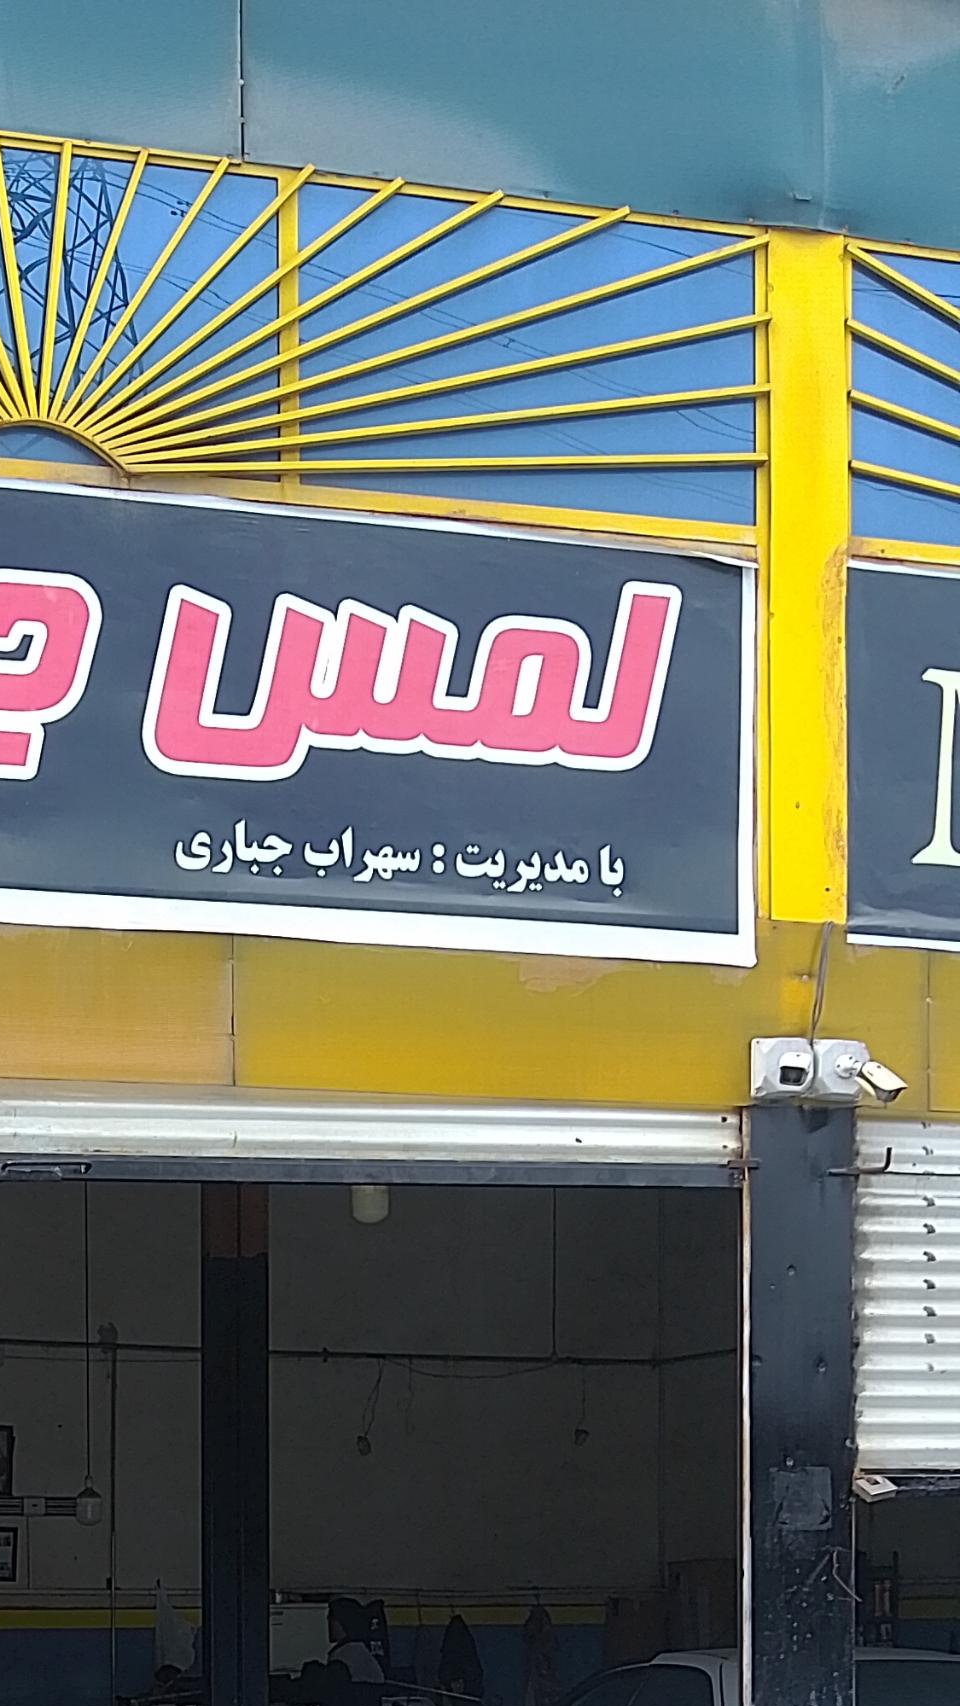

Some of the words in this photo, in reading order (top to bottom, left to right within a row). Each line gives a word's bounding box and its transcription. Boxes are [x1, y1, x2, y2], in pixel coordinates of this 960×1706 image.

[142, 581, 682, 781] لمس
[175, 819, 293, 876] جباری
[304, 826, 421, 883] سهراب
[455, 844, 589, 893] مدیریت
[599, 844, 624, 897] با
